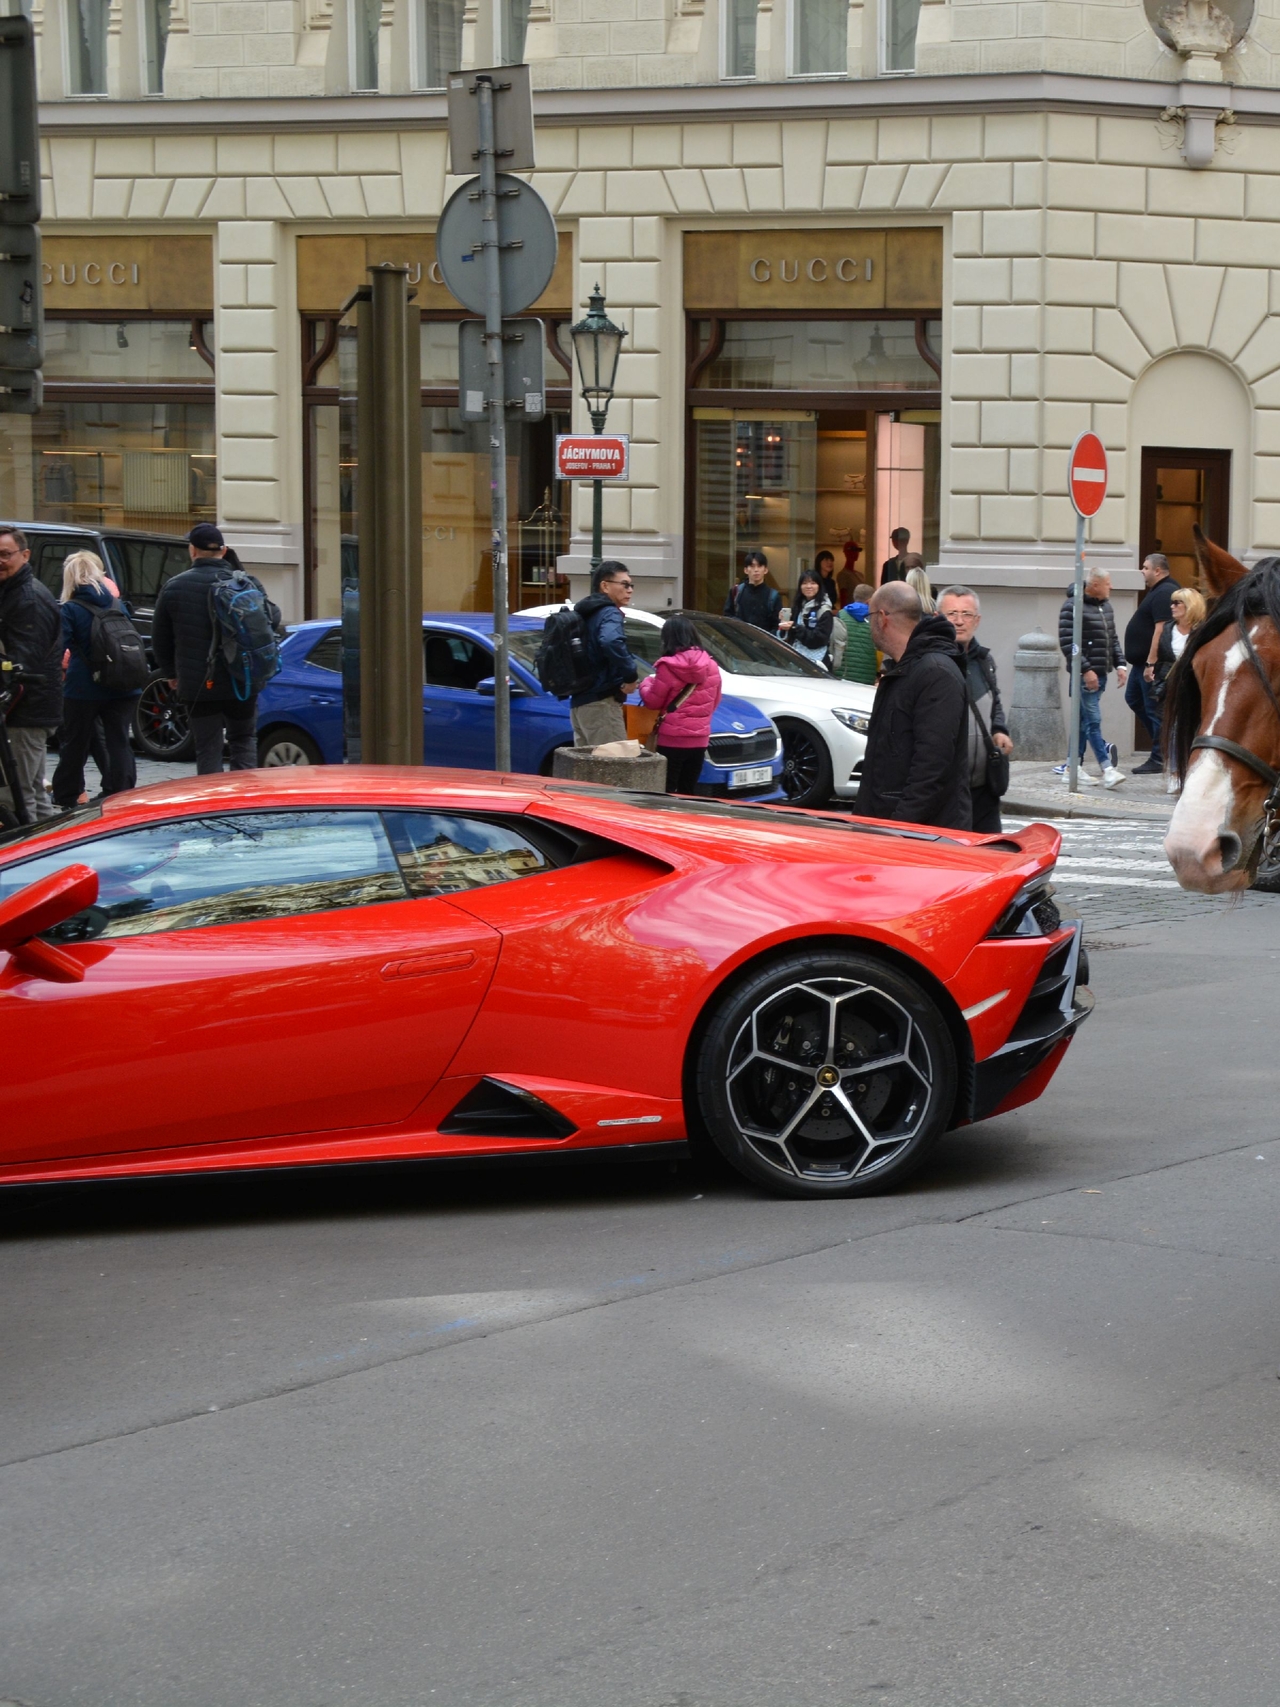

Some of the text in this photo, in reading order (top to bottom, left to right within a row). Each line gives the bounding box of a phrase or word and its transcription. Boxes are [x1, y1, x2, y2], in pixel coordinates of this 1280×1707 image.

[750, 257, 872, 282] GUCCI
[561, 445, 620, 460] JÁCHYMOVA
[565, 462, 588, 470] JOSEFOV
[592, 462, 612, 470] PRAHA
[611, 462, 616, 470] 1
